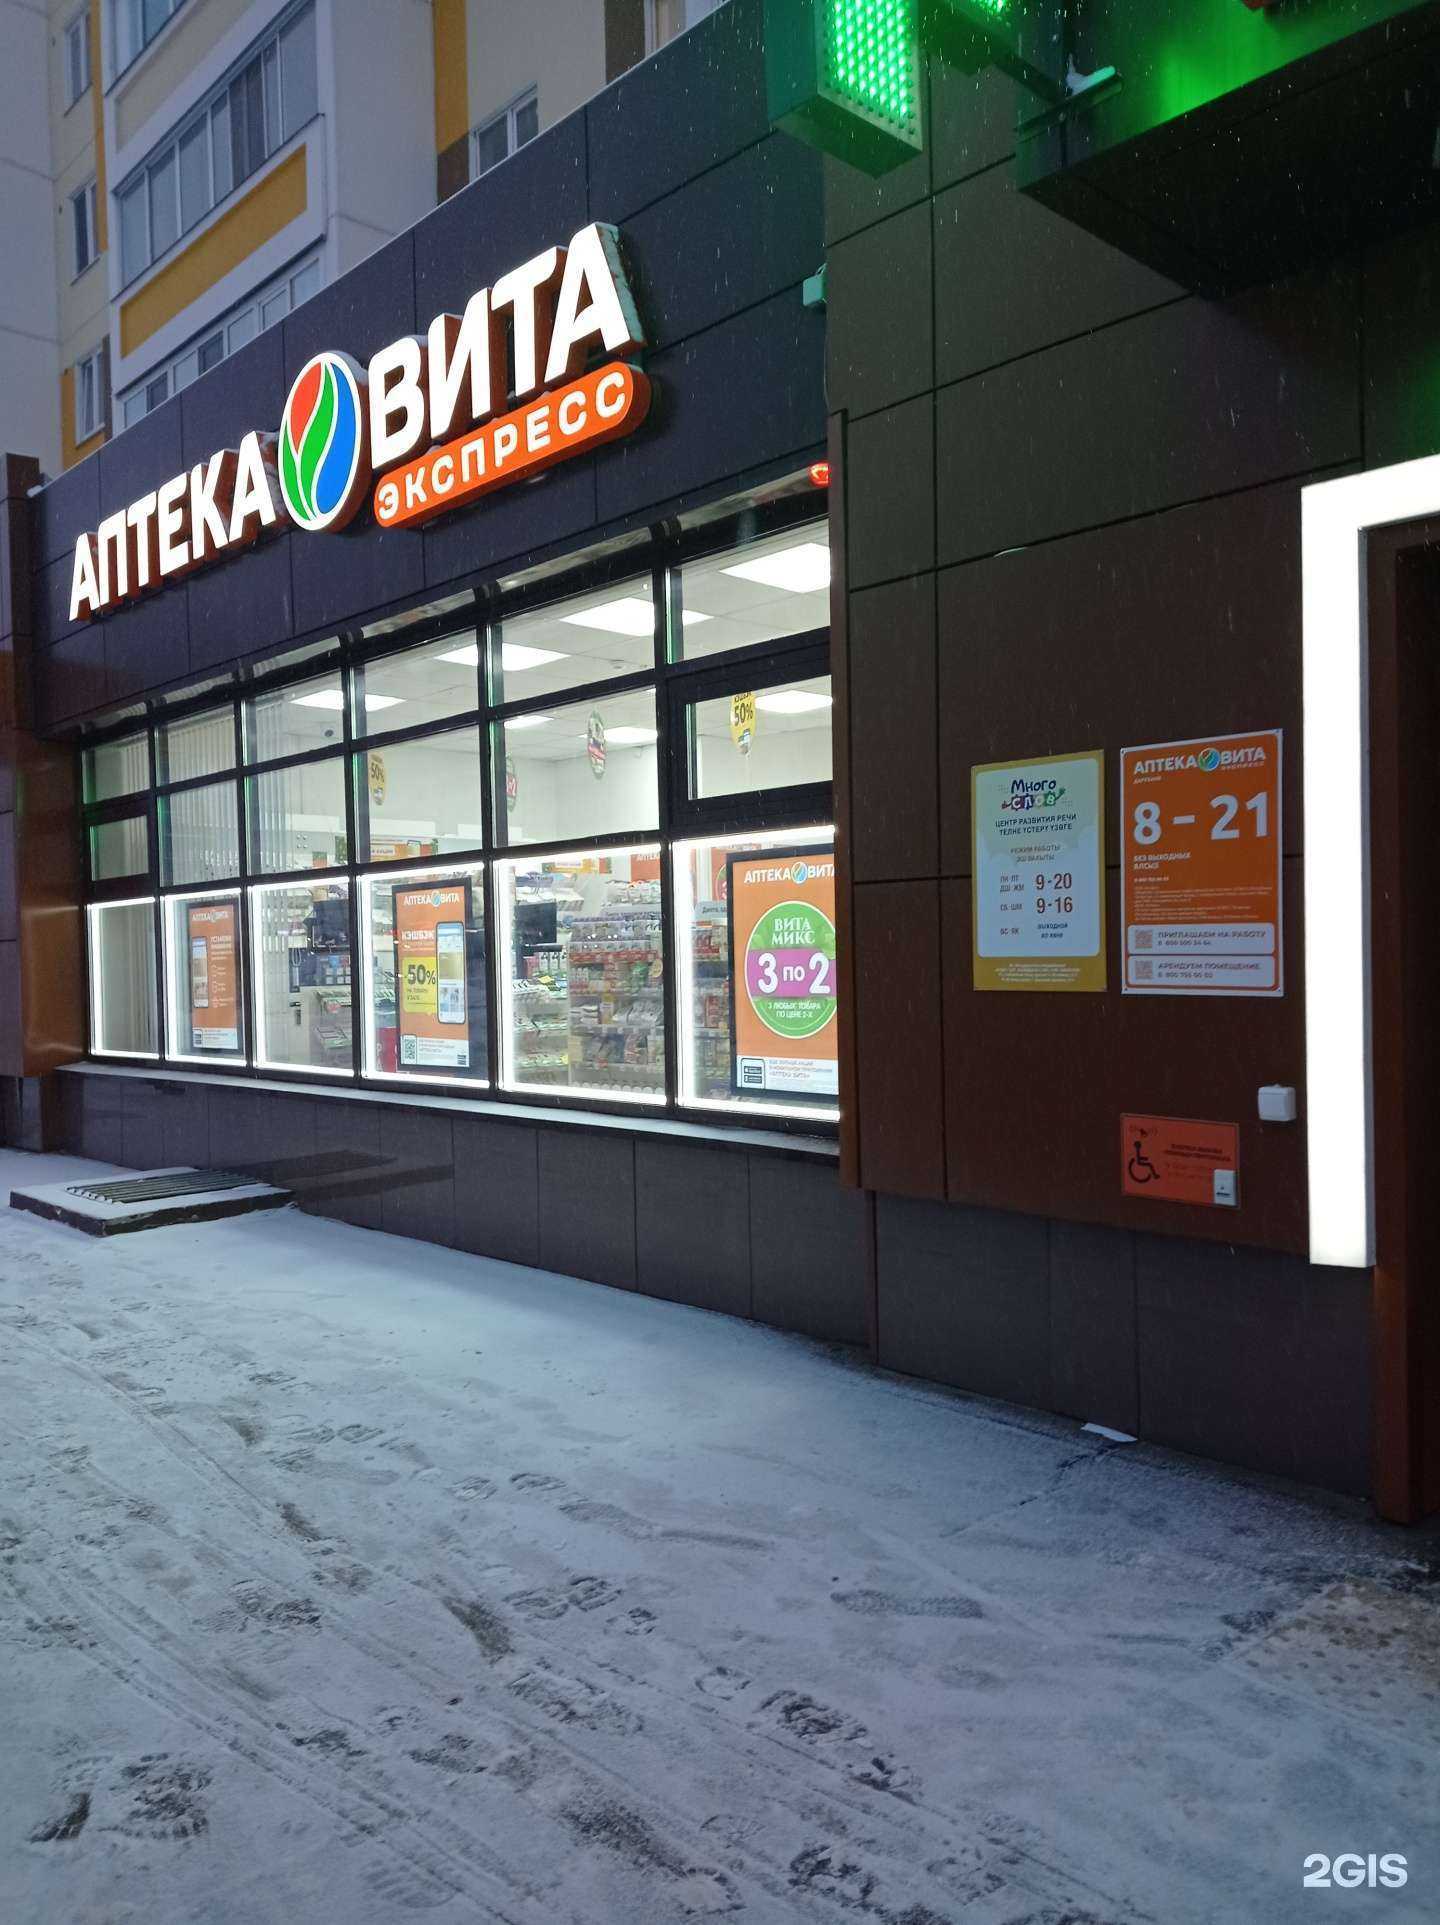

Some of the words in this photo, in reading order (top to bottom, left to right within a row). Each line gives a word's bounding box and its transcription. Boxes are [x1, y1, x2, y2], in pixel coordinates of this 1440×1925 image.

[69, 431, 276, 621] АПТЕКА
[369, 222, 631, 468] ВИТА
[376, 369, 627, 521] ЭКСПРЕСС
[734, 702, 753, 727] 50%
[1133, 754, 1198, 775] АПТЕКА
[1219, 746, 1267, 766] ВИТА
[1010, 779, 1056, 794] Много
[995, 818, 1017, 830] ЦЕНТР
[1018, 815, 1055, 827] РАЗВИТИЯ
[1057, 812, 1077, 823] РЕЧИ
[1133, 801, 1162, 846] 8
[1210, 791, 1269, 841] 21
[744, 866, 790, 883] АПТЕКА
[404, 894, 431, 906] АПТЕКА
[440, 892, 460, 904] ВИТА
[774, 917, 812, 932] ВИТА
[408, 964, 436, 985] 50%
[758, 952, 778, 994] 3
[809, 952, 831, 994] 2
